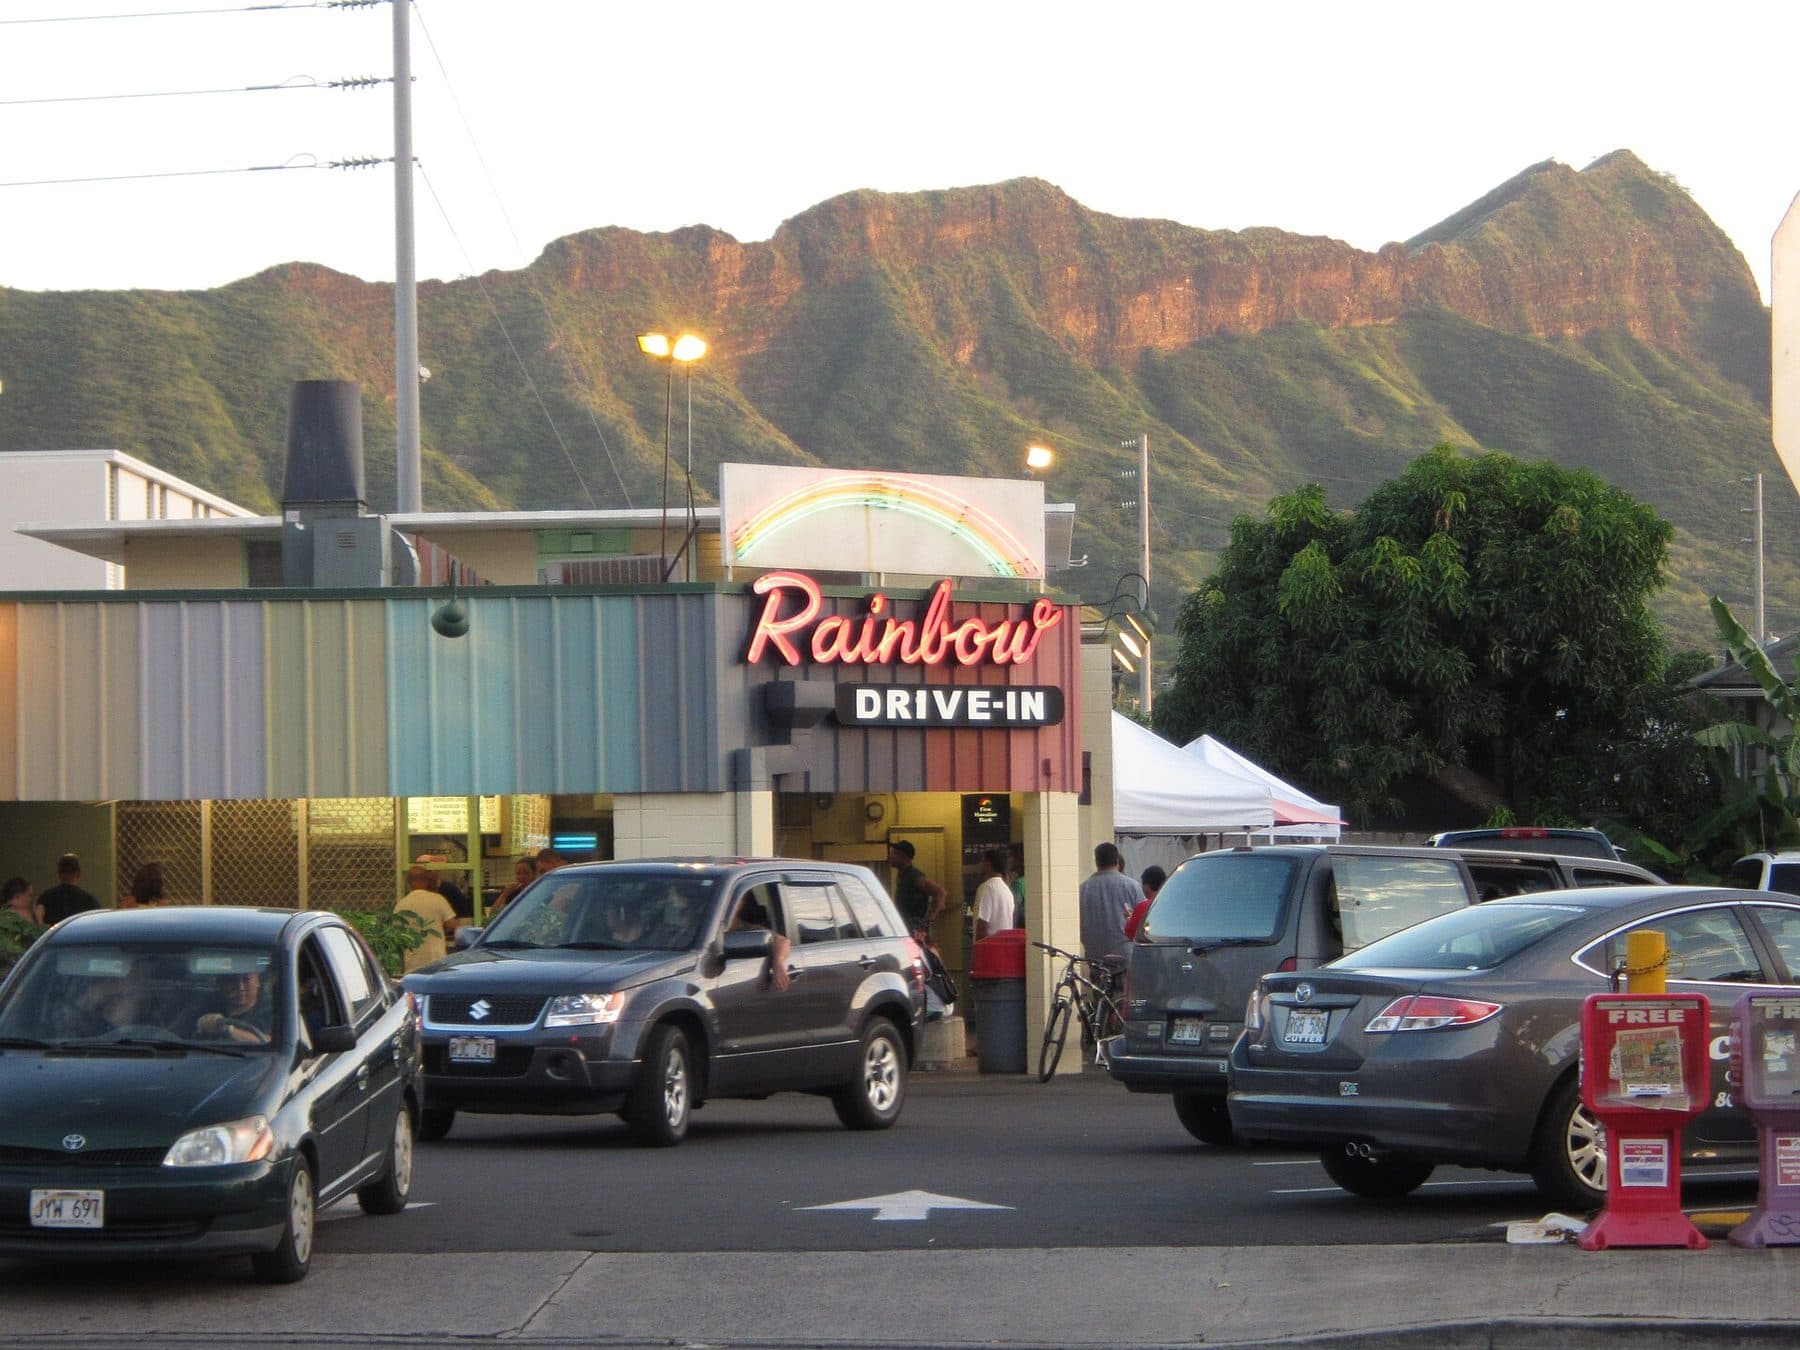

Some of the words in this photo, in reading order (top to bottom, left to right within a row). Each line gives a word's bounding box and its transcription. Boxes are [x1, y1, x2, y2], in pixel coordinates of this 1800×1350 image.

[747, 570, 1064, 666] Rainbow
[856, 688, 1045, 721] DRIVE-IN
[1608, 1009, 1685, 1024] FREE
[1284, 1035, 1322, 1043] CUTTER
[32, 1198, 62, 1218] JYW
[72, 1198, 98, 1218] 697
